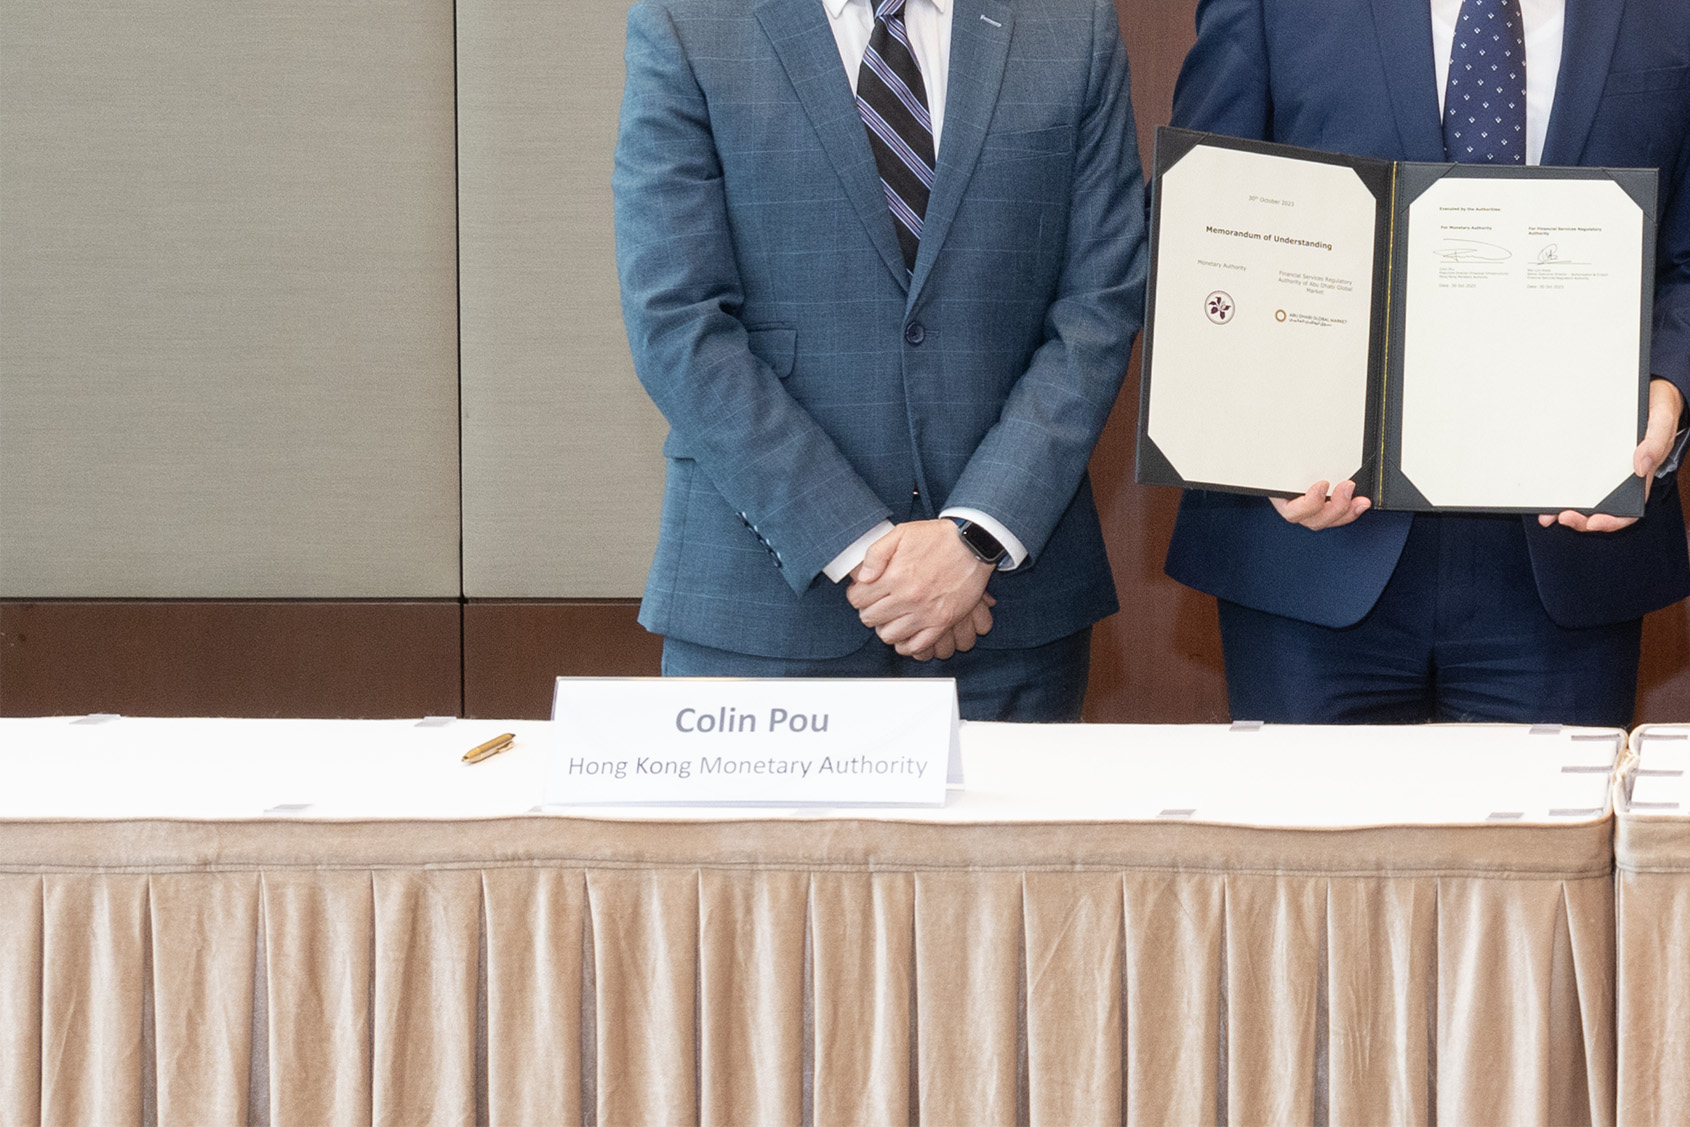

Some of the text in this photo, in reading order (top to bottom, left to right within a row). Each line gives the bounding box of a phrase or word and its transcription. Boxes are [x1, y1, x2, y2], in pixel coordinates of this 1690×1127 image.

[1259, 196, 1280, 205] October
[1206, 225, 1261, 240] Memorandum
[1273, 235, 1333, 251] Understanding
[1197, 259, 1247, 272] Monetary Authority
[675, 706, 830, 733] Colin Pou
[568, 755, 929, 779] Hong Kong Monetary Authority
